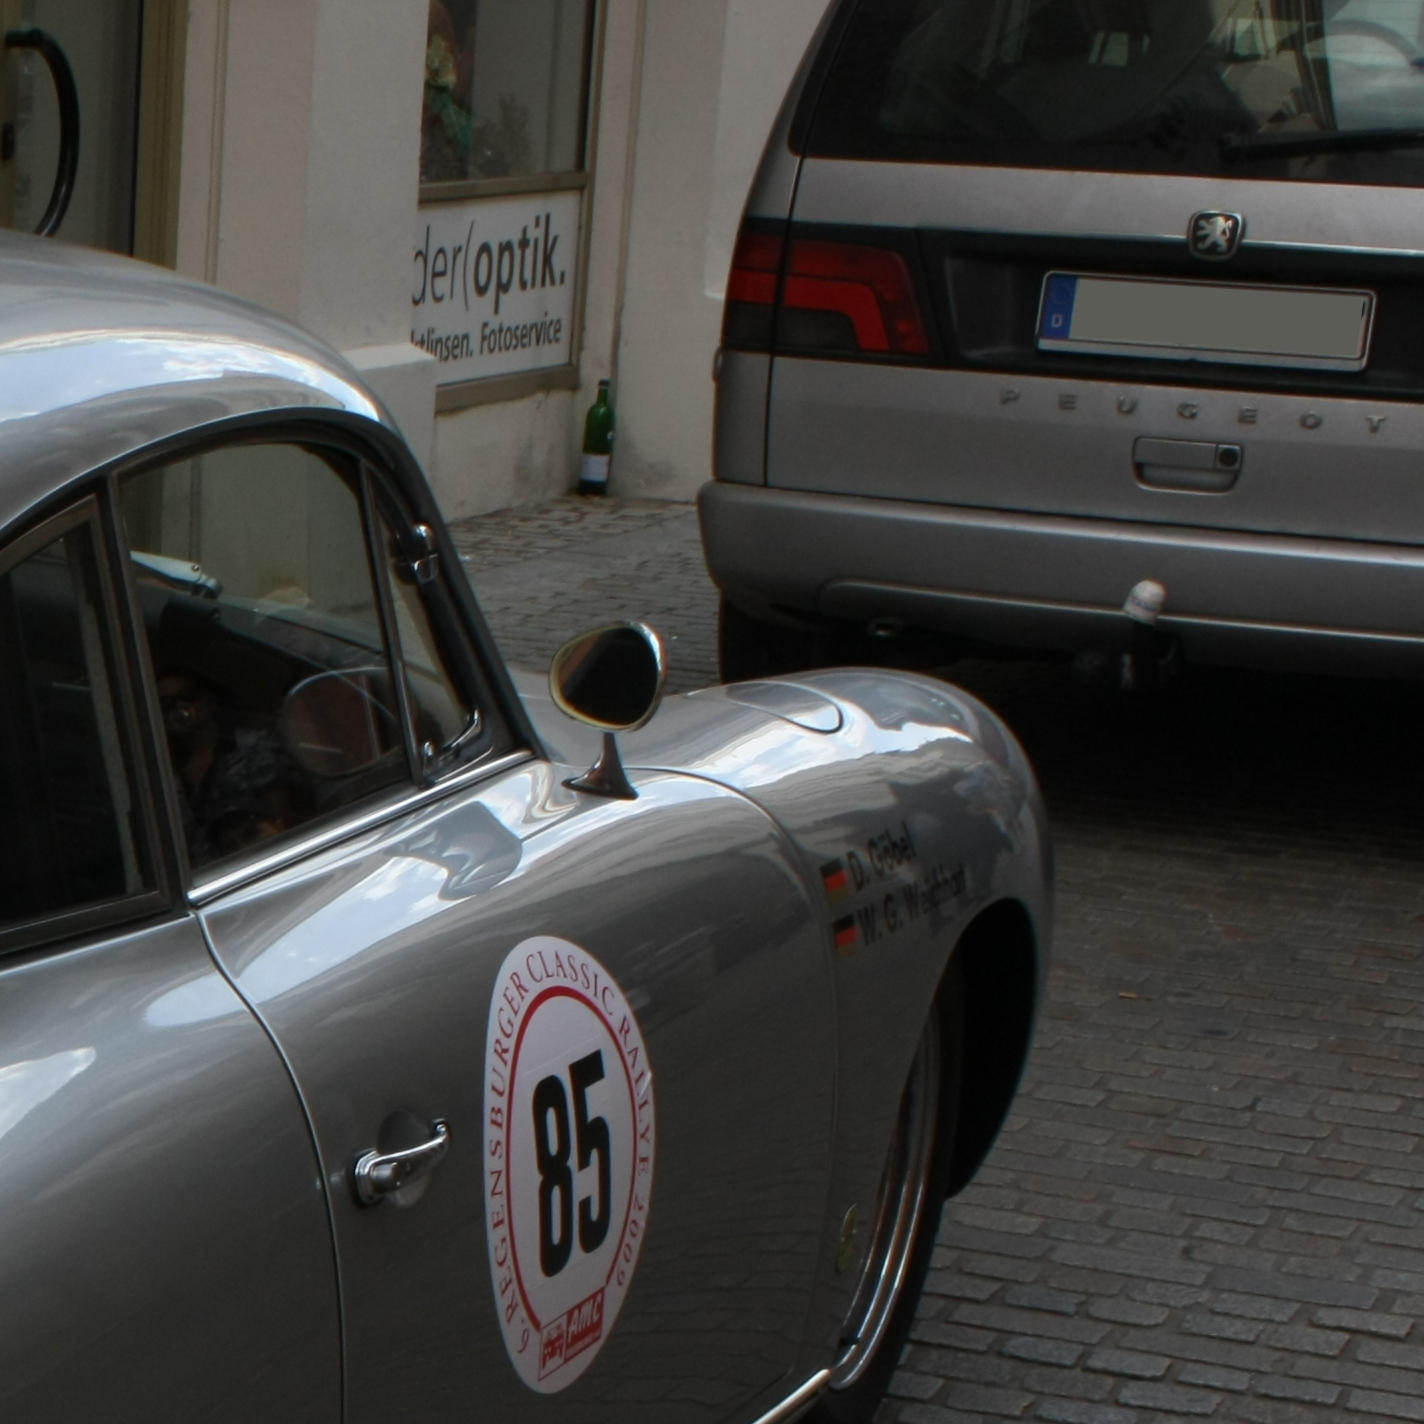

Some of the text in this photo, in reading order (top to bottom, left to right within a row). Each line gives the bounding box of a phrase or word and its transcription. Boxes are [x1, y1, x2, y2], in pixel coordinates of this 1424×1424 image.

[479, 311, 563, 356] Fotoservice
[1051, 313, 1063, 328] D
[1000, 389, 1387, 434] PEUGEOT
[525, 949, 616, 1018] CLASSIC
[617, 1012, 652, 1179] RALLYE
[487, 968, 530, 1327] REGENSBURGER
[531, 1047, 613, 1279] 85
[615, 1190, 649, 1288] 2009
[567, 1291, 603, 1344] AMC
